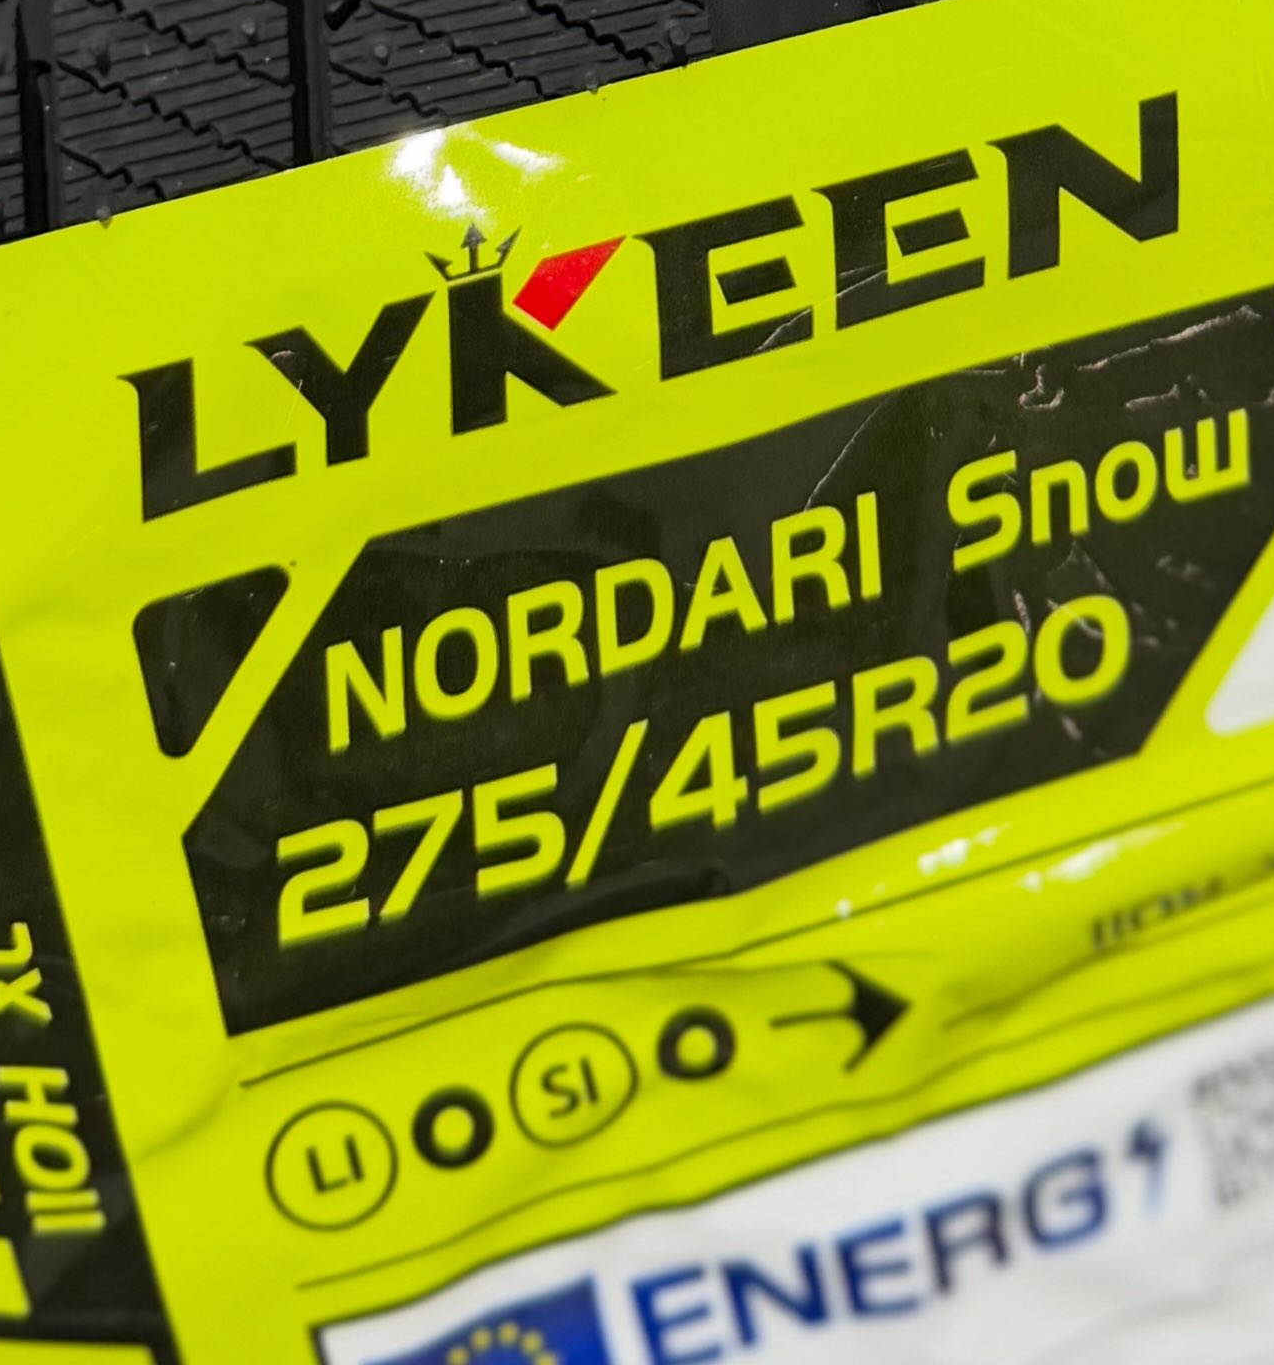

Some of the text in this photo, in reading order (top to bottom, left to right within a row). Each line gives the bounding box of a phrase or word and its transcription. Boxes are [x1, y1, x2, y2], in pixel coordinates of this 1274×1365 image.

[117, 90, 1180, 523] LYKEEN
[323, 407, 1252, 754] NORDARI Snow
[276, 630, 1133, 949] 275/45R20
[630, 1148, 1113, 1365] ENERG
